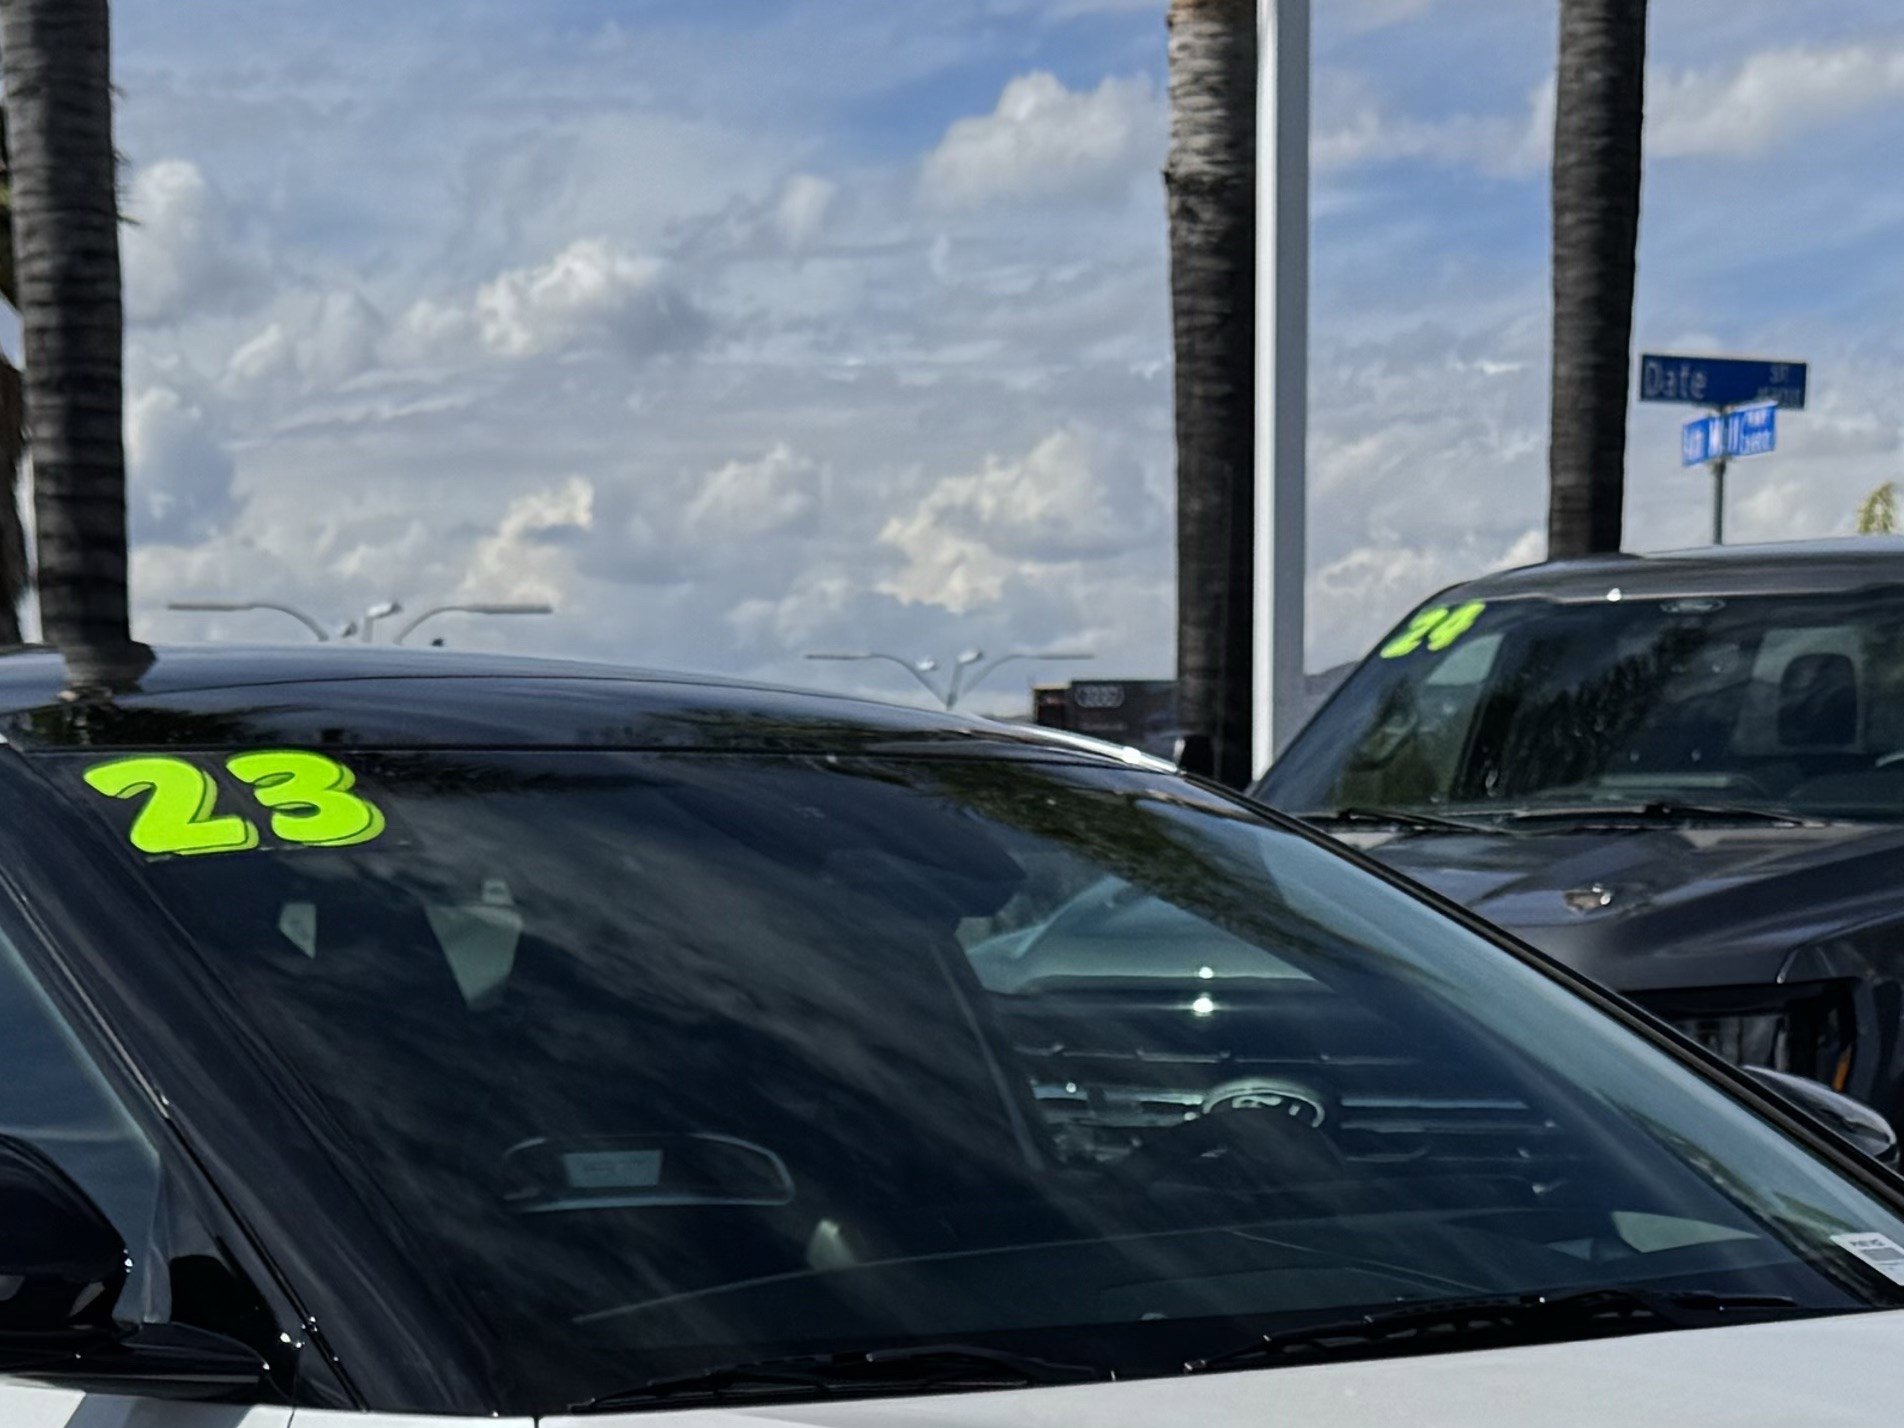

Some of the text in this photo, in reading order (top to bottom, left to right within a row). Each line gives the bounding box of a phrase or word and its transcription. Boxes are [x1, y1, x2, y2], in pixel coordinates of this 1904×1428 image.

[1646, 361, 1707, 400] Date
[1379, 599, 1486, 658] 24
[83, 750, 386, 856] 23
